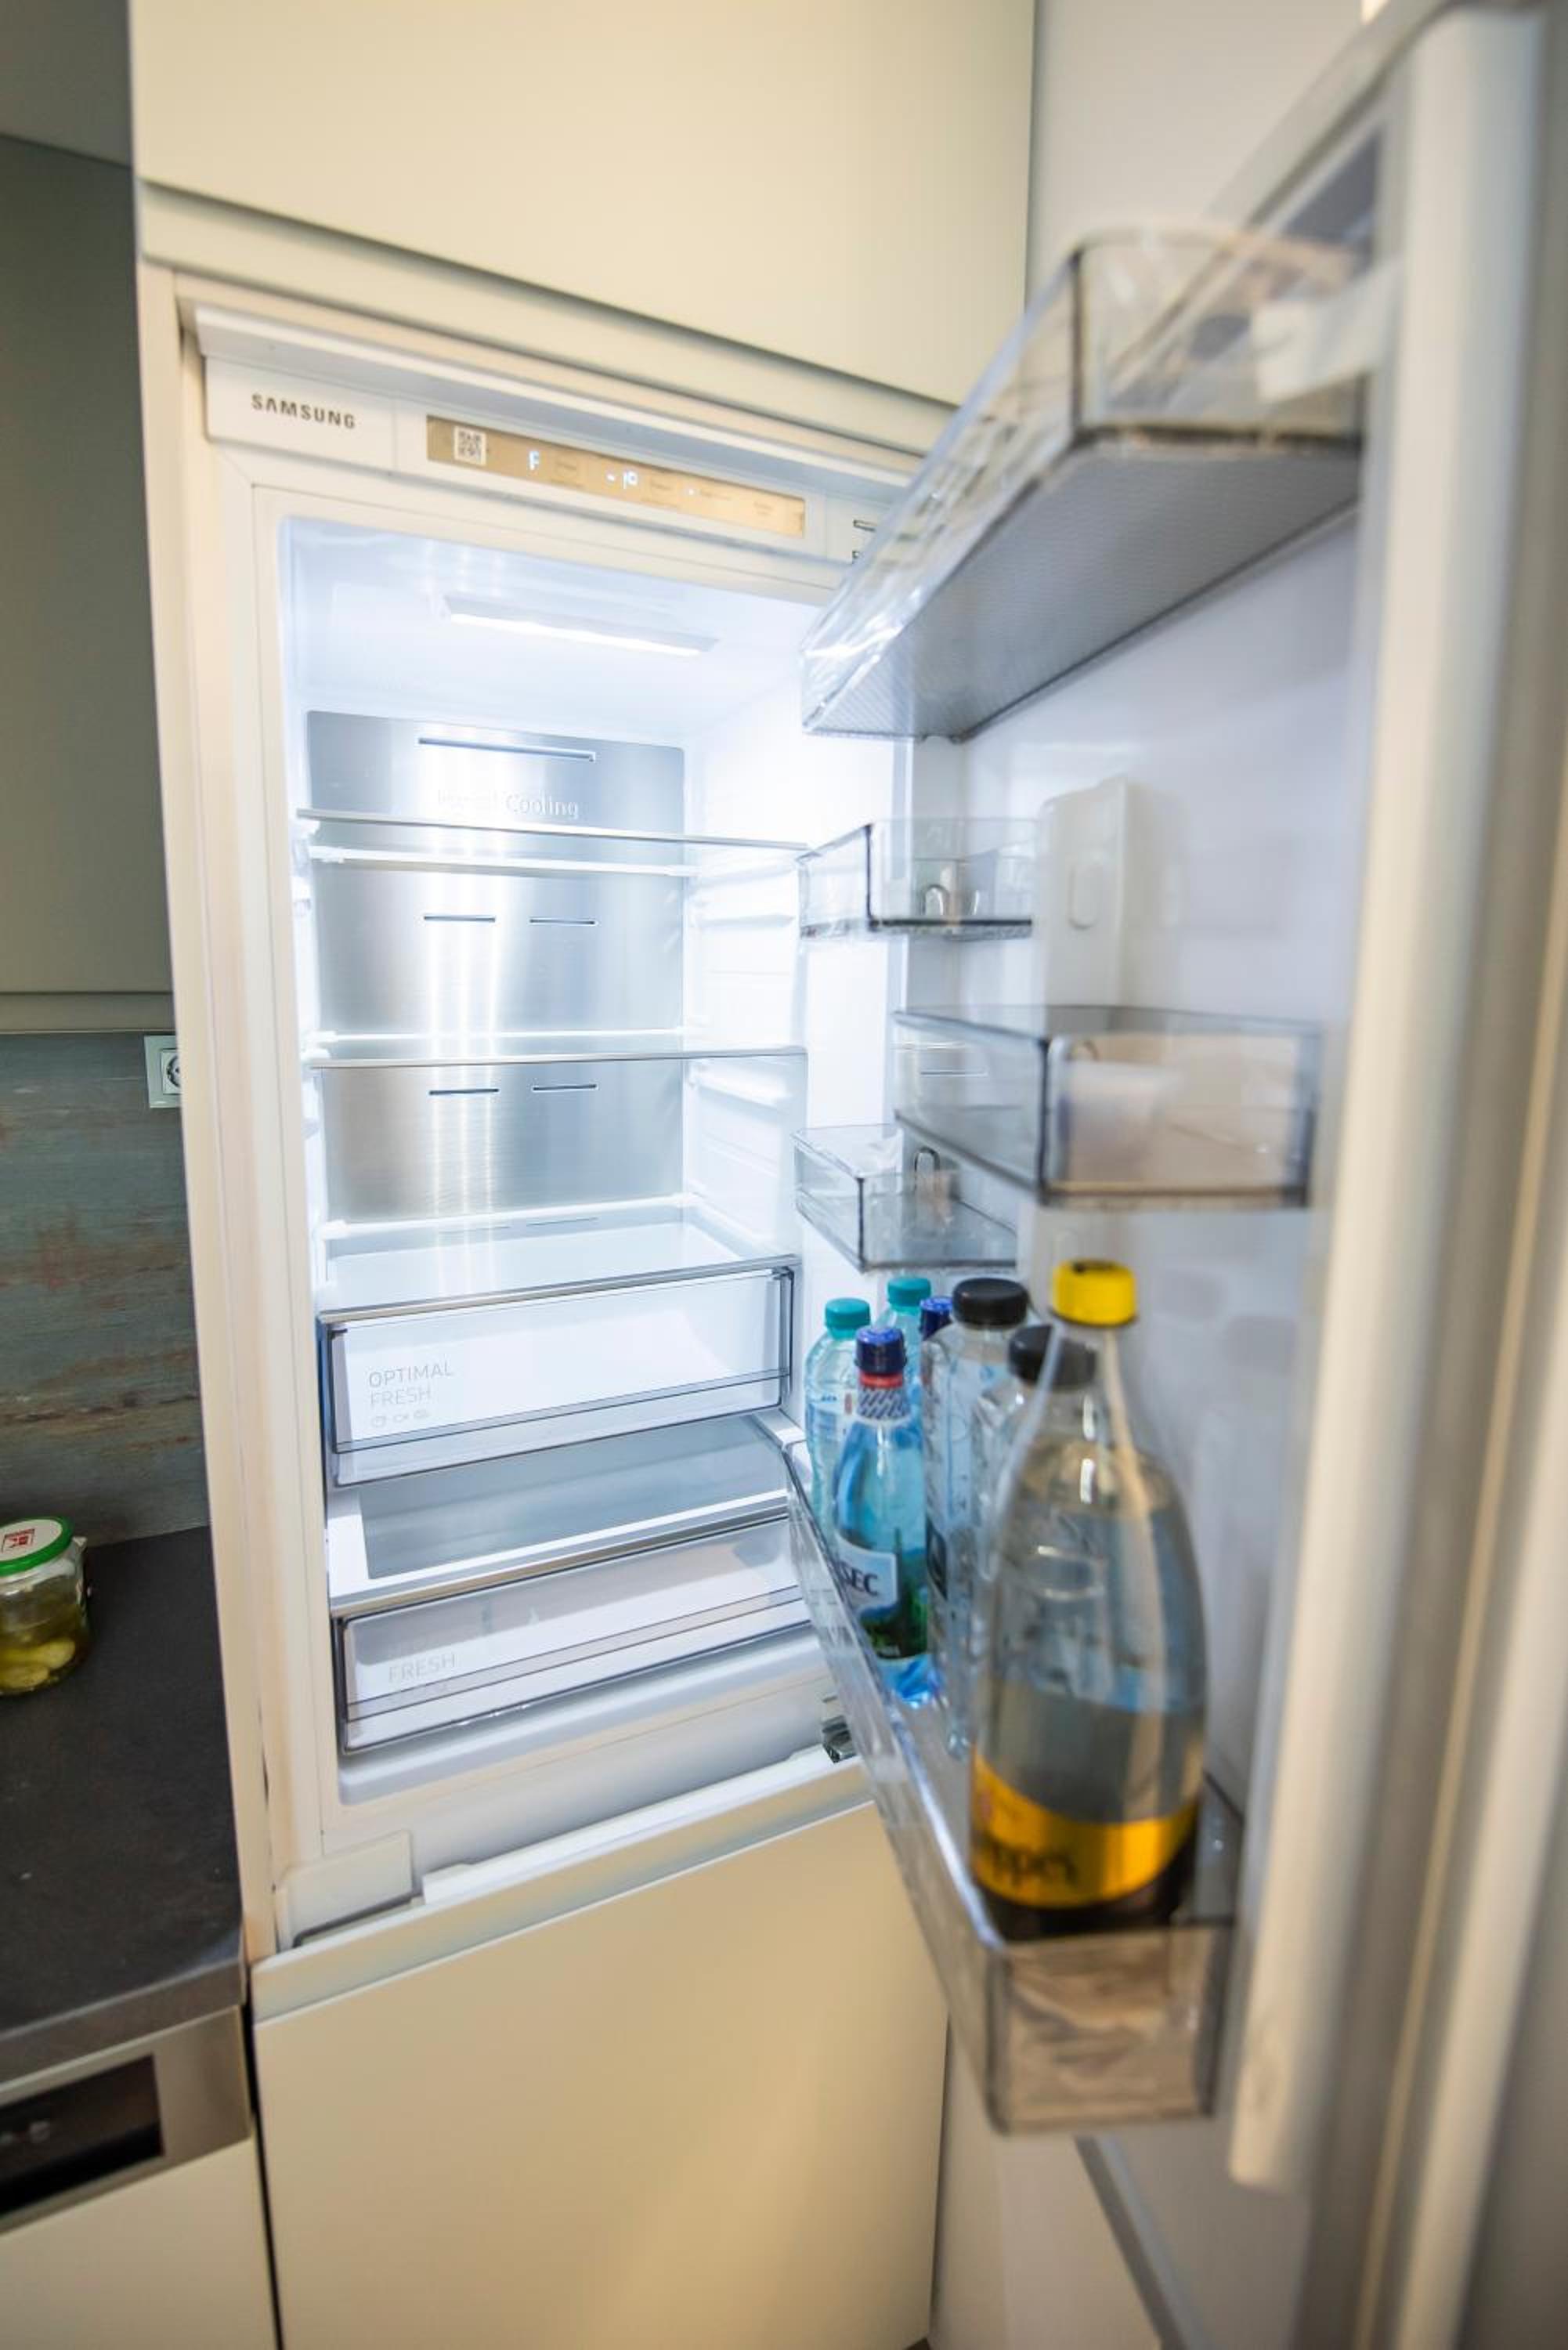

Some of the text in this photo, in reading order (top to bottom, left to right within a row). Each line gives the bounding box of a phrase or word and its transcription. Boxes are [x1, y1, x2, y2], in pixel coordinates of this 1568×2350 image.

[251, 392, 356, 429] SAMSUNG
[505, 793, 580, 819] Cooling
[370, 1360, 453, 1387] OPTIMAL
[370, 1384, 431, 1406] FRESH
[389, 1653, 455, 1682] FRESH
